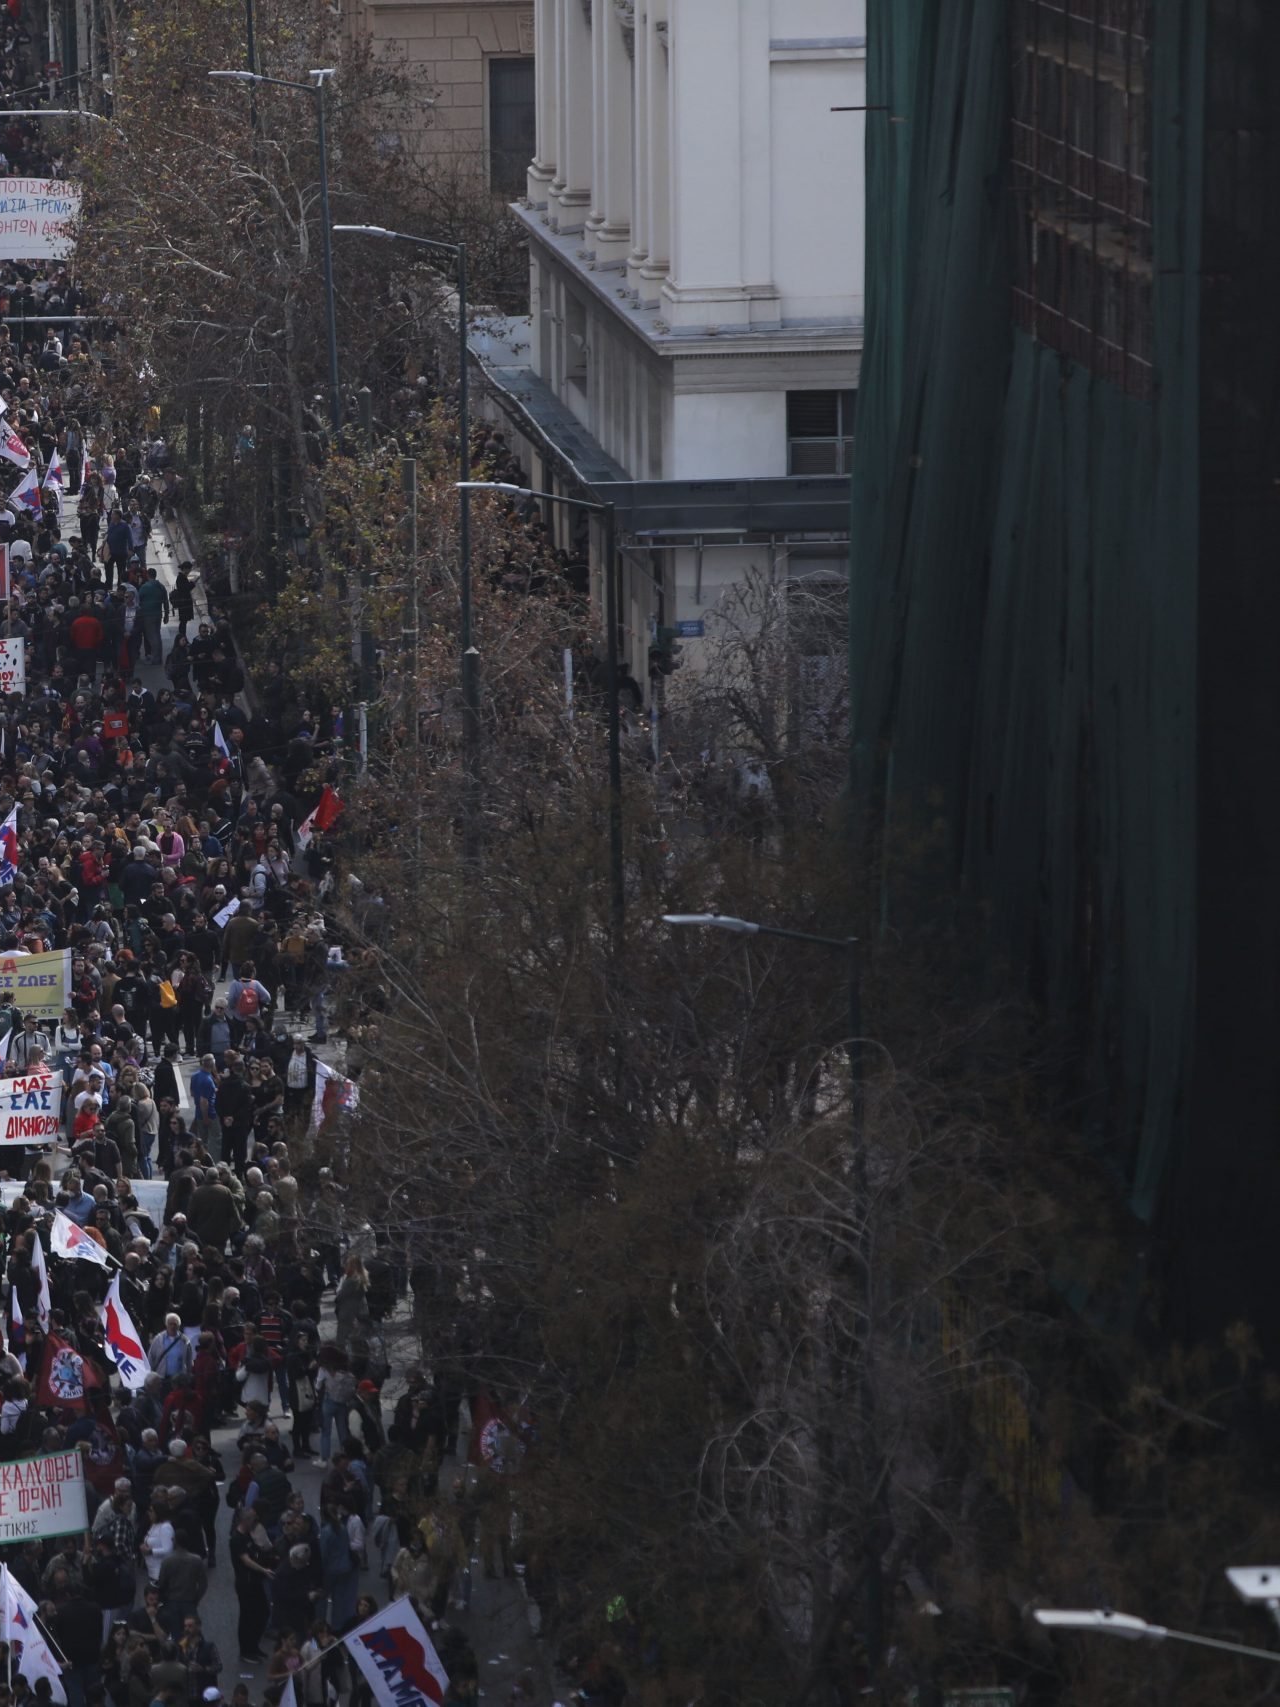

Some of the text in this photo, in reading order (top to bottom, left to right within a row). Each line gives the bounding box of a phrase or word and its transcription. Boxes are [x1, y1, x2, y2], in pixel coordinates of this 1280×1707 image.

[11, 198, 27, 213] ΣΤΑ
[36, 199, 69, 215] ΤΡΕΝΑ
[18, 974, 57, 988] ΖΩΕΣ
[13, 1075, 53, 1094] ΜΑΣ
[10, 1091, 51, 1111] ΣΑΣ
[18, 1484, 63, 1513] ΦΩΝΗ
